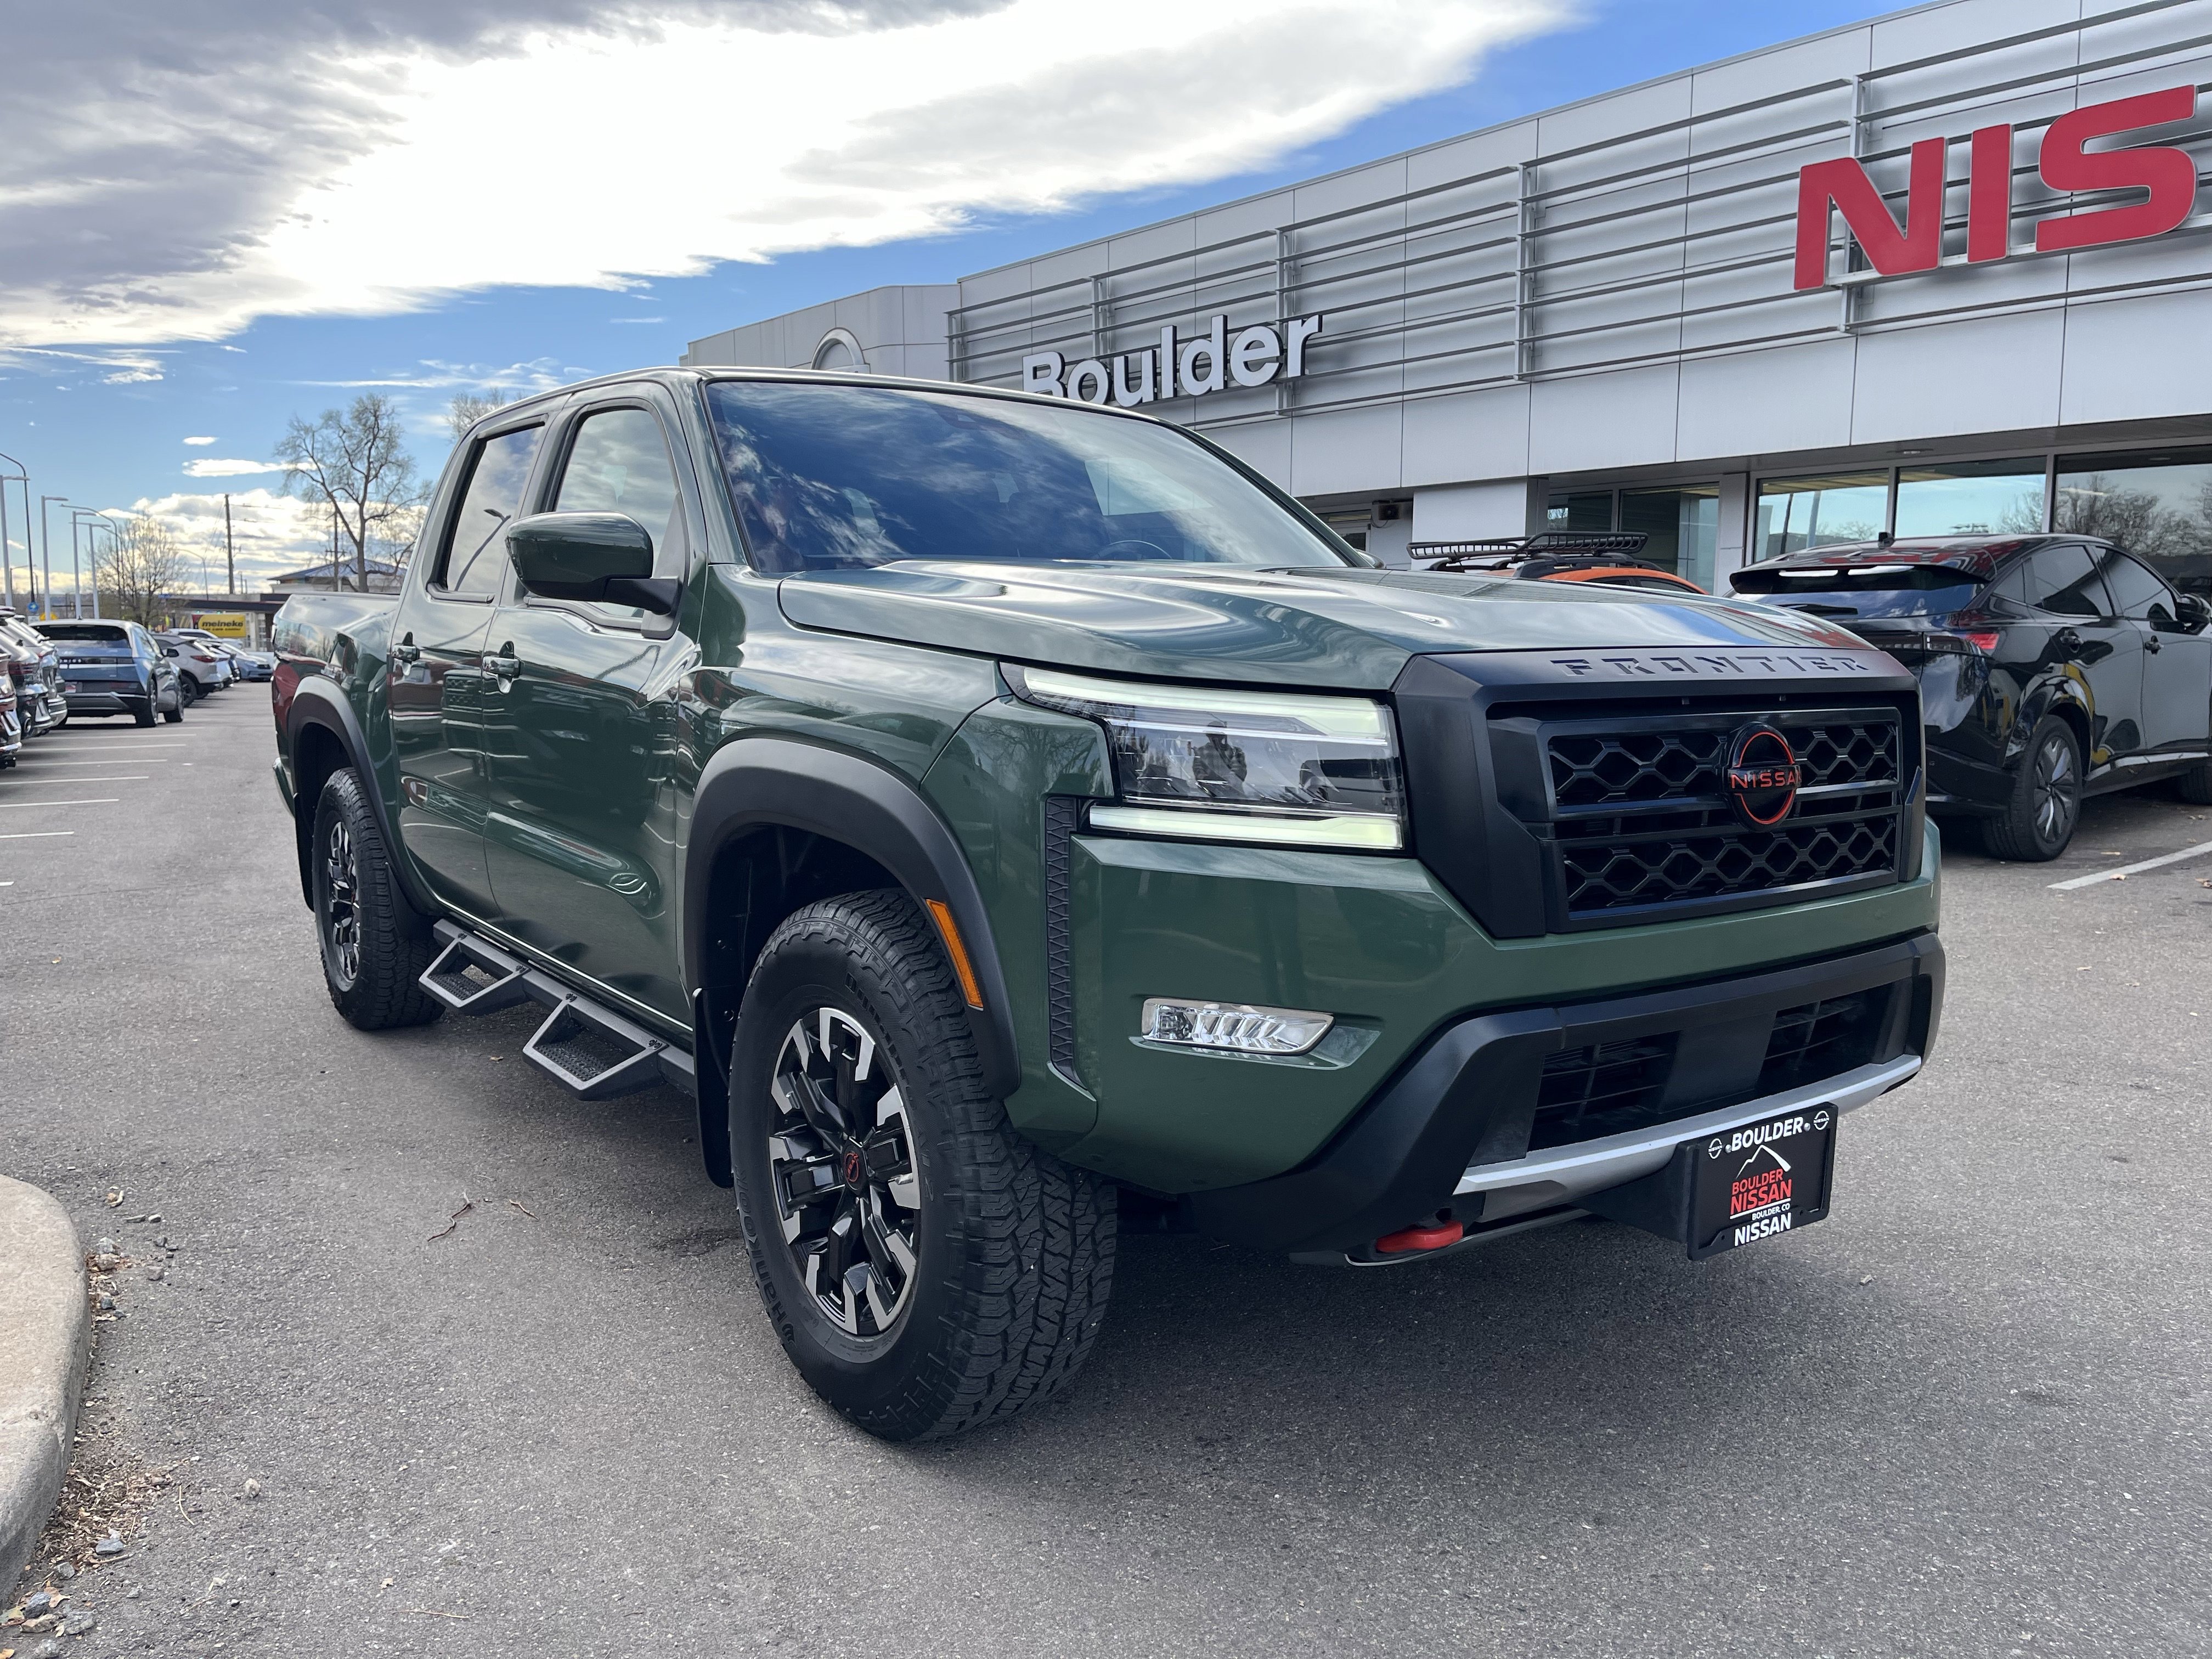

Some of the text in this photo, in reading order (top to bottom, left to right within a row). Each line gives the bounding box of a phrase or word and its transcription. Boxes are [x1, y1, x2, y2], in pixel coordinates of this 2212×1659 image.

[1794, 84, 2198, 291] NIS
[1022, 314, 1322, 408] Boulder
[1550, 656, 1870, 676] FRONTIER
[1731, 1116, 1804, 1152] BOULDER
[1730, 1179, 1792, 1215] NISSAN
[1732, 1168, 1784, 1195] BOULDER
[1781, 1203, 1790, 1211] CO
[1734, 1212, 1791, 1246] NISSAN
